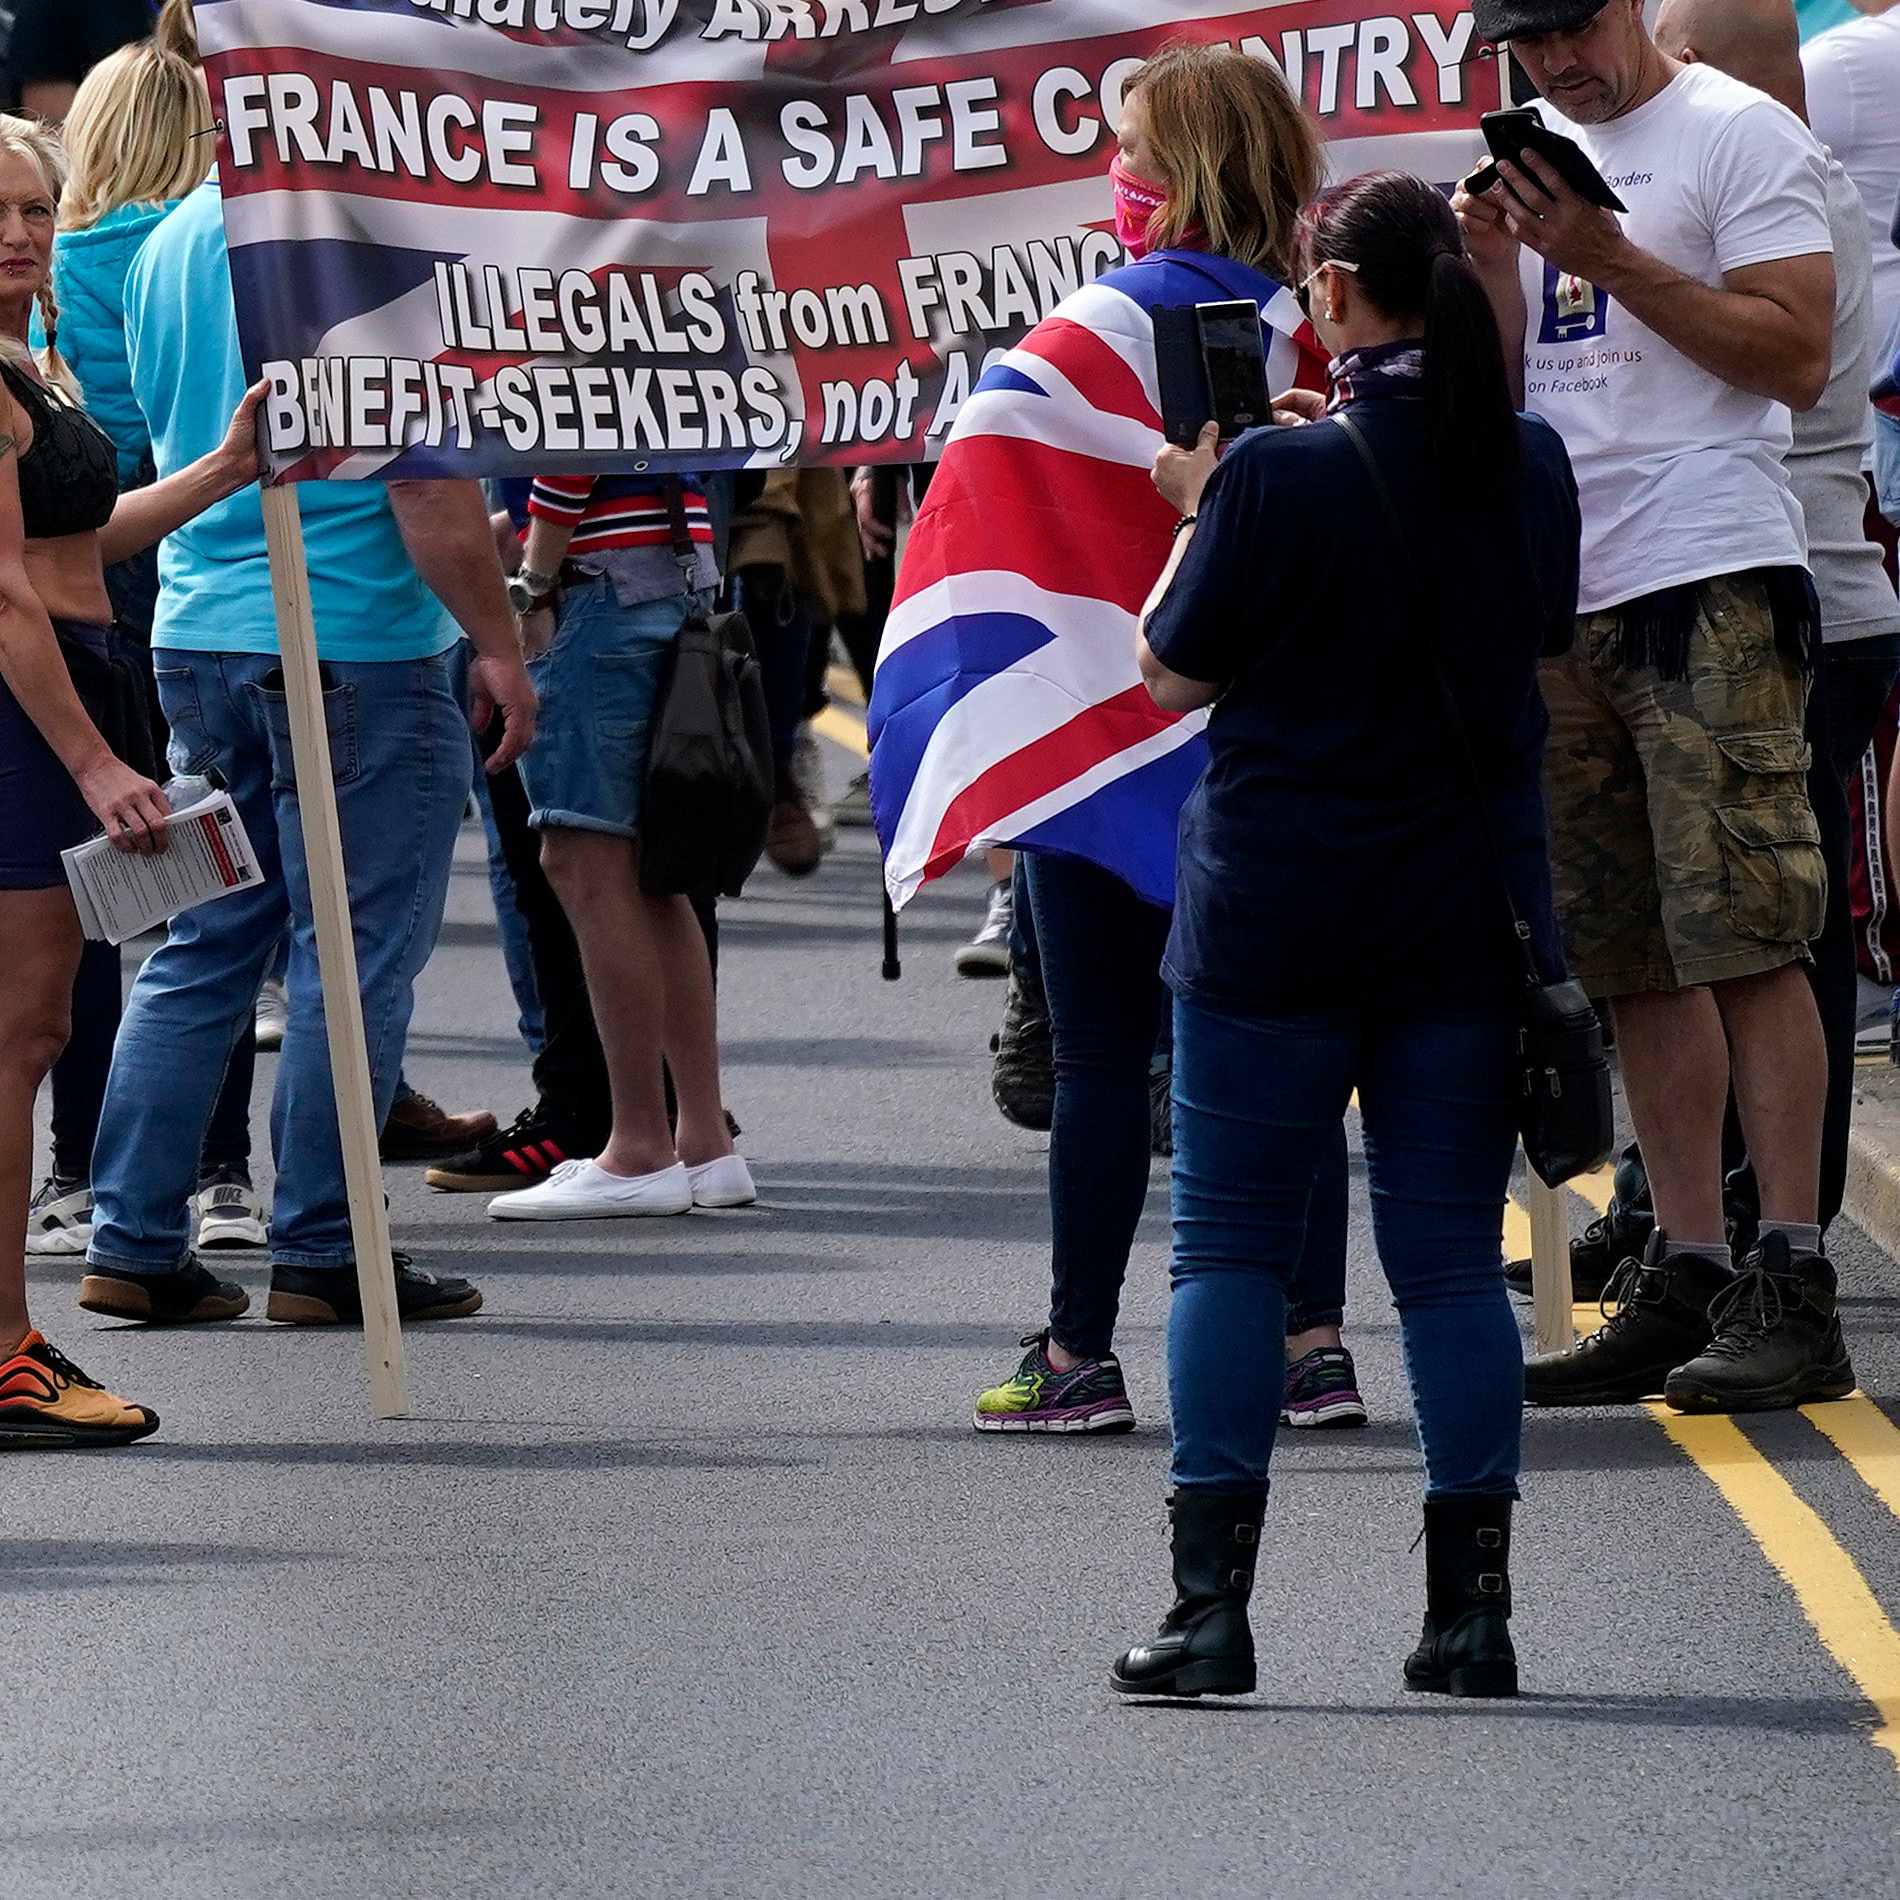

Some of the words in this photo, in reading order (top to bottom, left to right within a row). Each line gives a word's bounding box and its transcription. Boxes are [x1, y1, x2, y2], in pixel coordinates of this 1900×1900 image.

[221, 72, 538, 188] FRANCE
[569, 112, 661, 195] IS
[687, 106, 753, 197] A
[779, 76, 1008, 189] SAFE
[1032, 11, 1477, 157] CNTRY
[433, 260, 727, 354] ILLEGALS
[735, 269, 890, 353] from
[897, 229, 1130, 338] FRANC
[1528, 381, 1546, 393] on
[1550, 373, 1608, 394] Facebook
[1536, 357, 1553, 371] us
[1558, 359, 1575, 373] up
[1577, 352, 1595, 368] and
[1596, 349, 1620, 368] join
[1624, 350, 1642, 363] us
[262, 355, 804, 463] BENEFIT-SEEKERS,
[822, 357, 919, 444] not
[212, 1186, 243, 1206] NIKE
